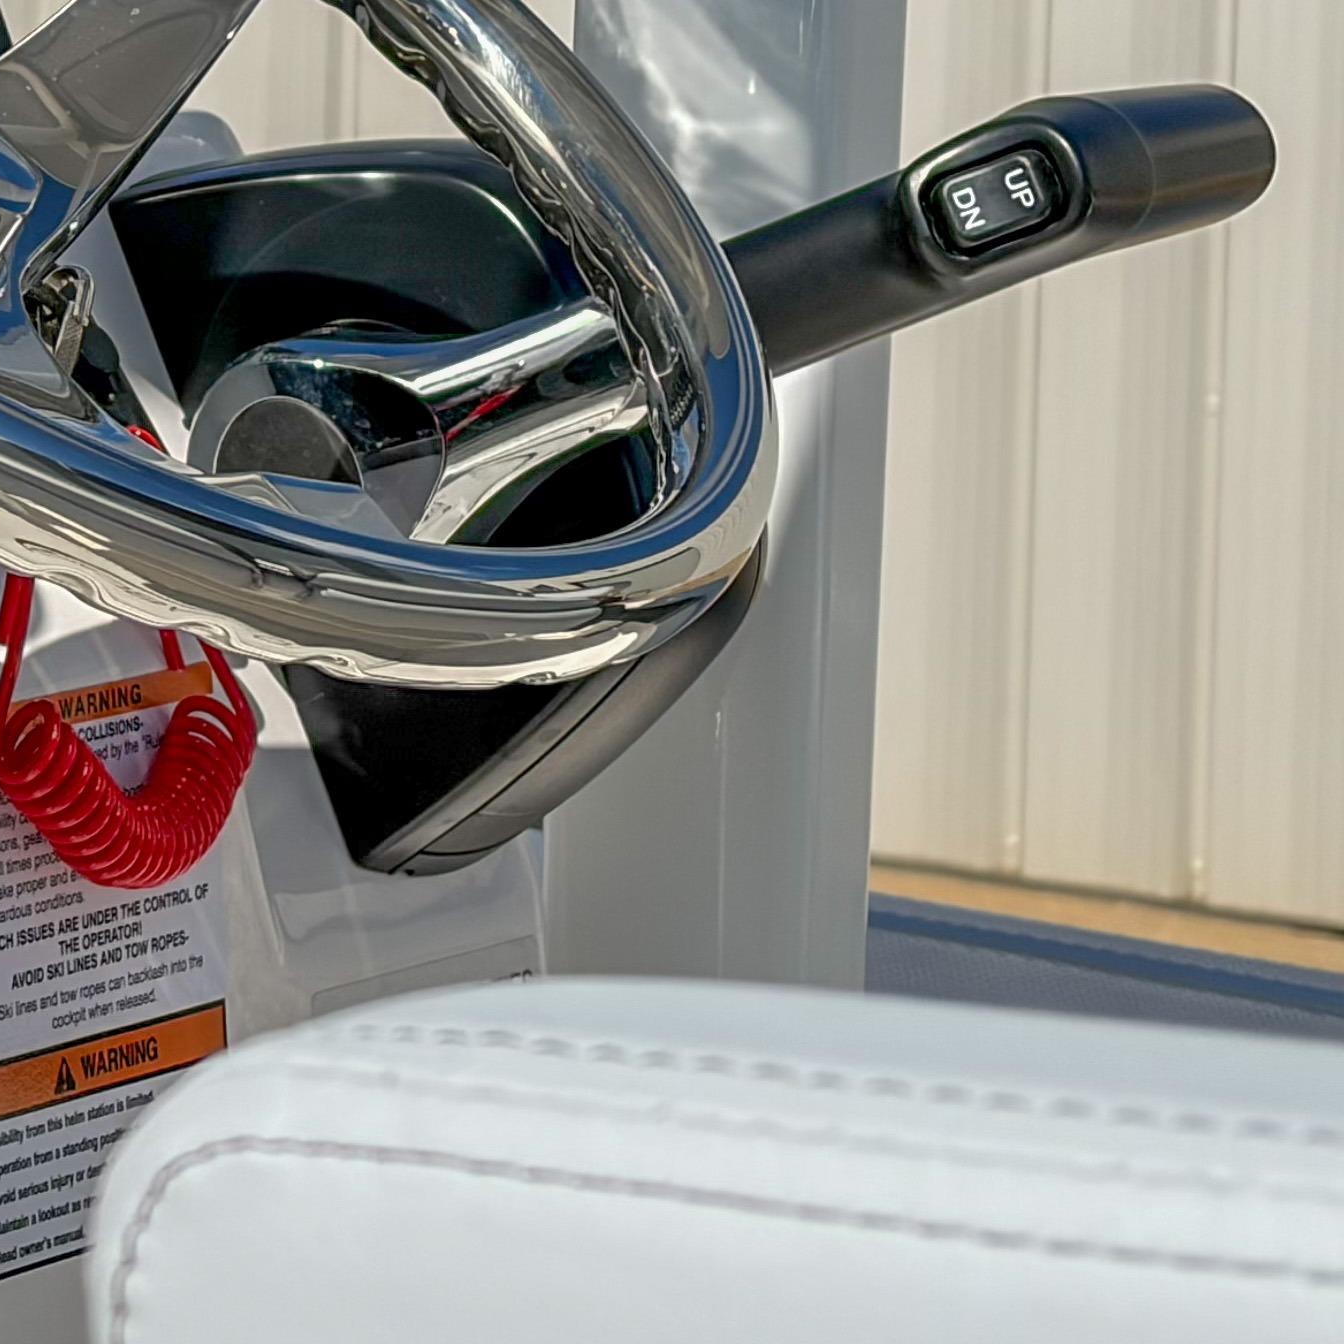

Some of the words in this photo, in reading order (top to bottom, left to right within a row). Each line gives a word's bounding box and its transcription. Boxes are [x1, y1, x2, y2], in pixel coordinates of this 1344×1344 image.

[1004, 168, 1036, 209] UP
[951, 186, 986, 231] DN
[58, 684, 142, 719] WARNING
[16, 876, 47, 898] proper
[17, 925, 55, 946] ISSUES
[58, 916, 79, 935] ARE
[82, 908, 118, 929] UNDER
[121, 901, 141, 920] THE
[143, 890, 192, 914] CONTROL
[195, 883, 209, 899] OF
[58, 938, 79, 956] THE
[11, 968, 44, 991] AVOID
[47, 962, 65, 980] SKI
[67, 953, 97, 974] LINES
[100, 946, 123, 966] AND
[125, 940, 149, 959] TOW
[40, 992, 58, 1010] and
[79, 982, 106, 1002] ropes
[80, 1036, 159, 1081] WARNING
[25, 1123, 46, 1139] from
[47, 1116, 63, 1131] this
[64, 1111, 86, 1127] helm
[87, 1102, 115, 1121] station
[33, 1150, 54, 1167] from
[62, 1137, 98, 1158] standing
[17, 1181, 49, 1201] serious
[50, 1173, 74, 1193] injury
[38, 1202, 70, 1223] lookout
